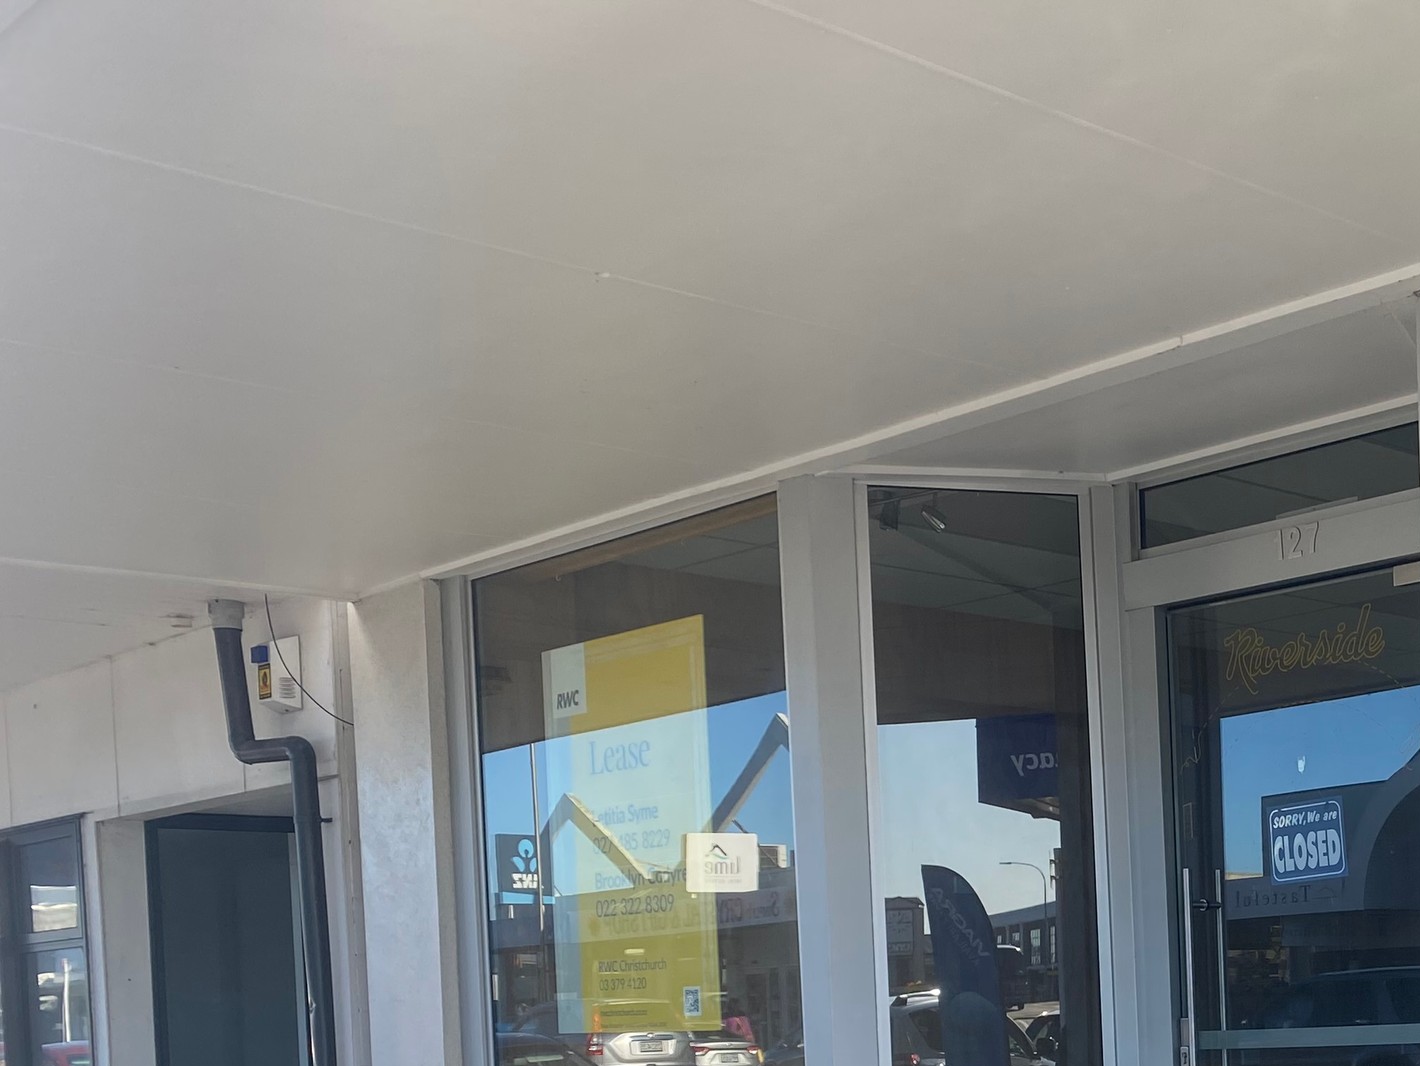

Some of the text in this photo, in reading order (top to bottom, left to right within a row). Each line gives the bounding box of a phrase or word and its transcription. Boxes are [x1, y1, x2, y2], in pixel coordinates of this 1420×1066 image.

[1274, 522, 1320, 561] 127
[1224, 603, 1386, 694] Riverside
[557, 690, 579, 710] RWC
[589, 739, 650, 775] Lease
[627, 804, 659, 824] Syme
[1323, 810, 1337, 821] are
[641, 828, 670, 848] 8229
[1274, 829, 1341, 873] CLOSED
[595, 899, 617, 918] 022
[620, 897, 641, 915] 322
[645, 893, 675, 913] 8309
[619, 957, 667, 972] Christchurch
